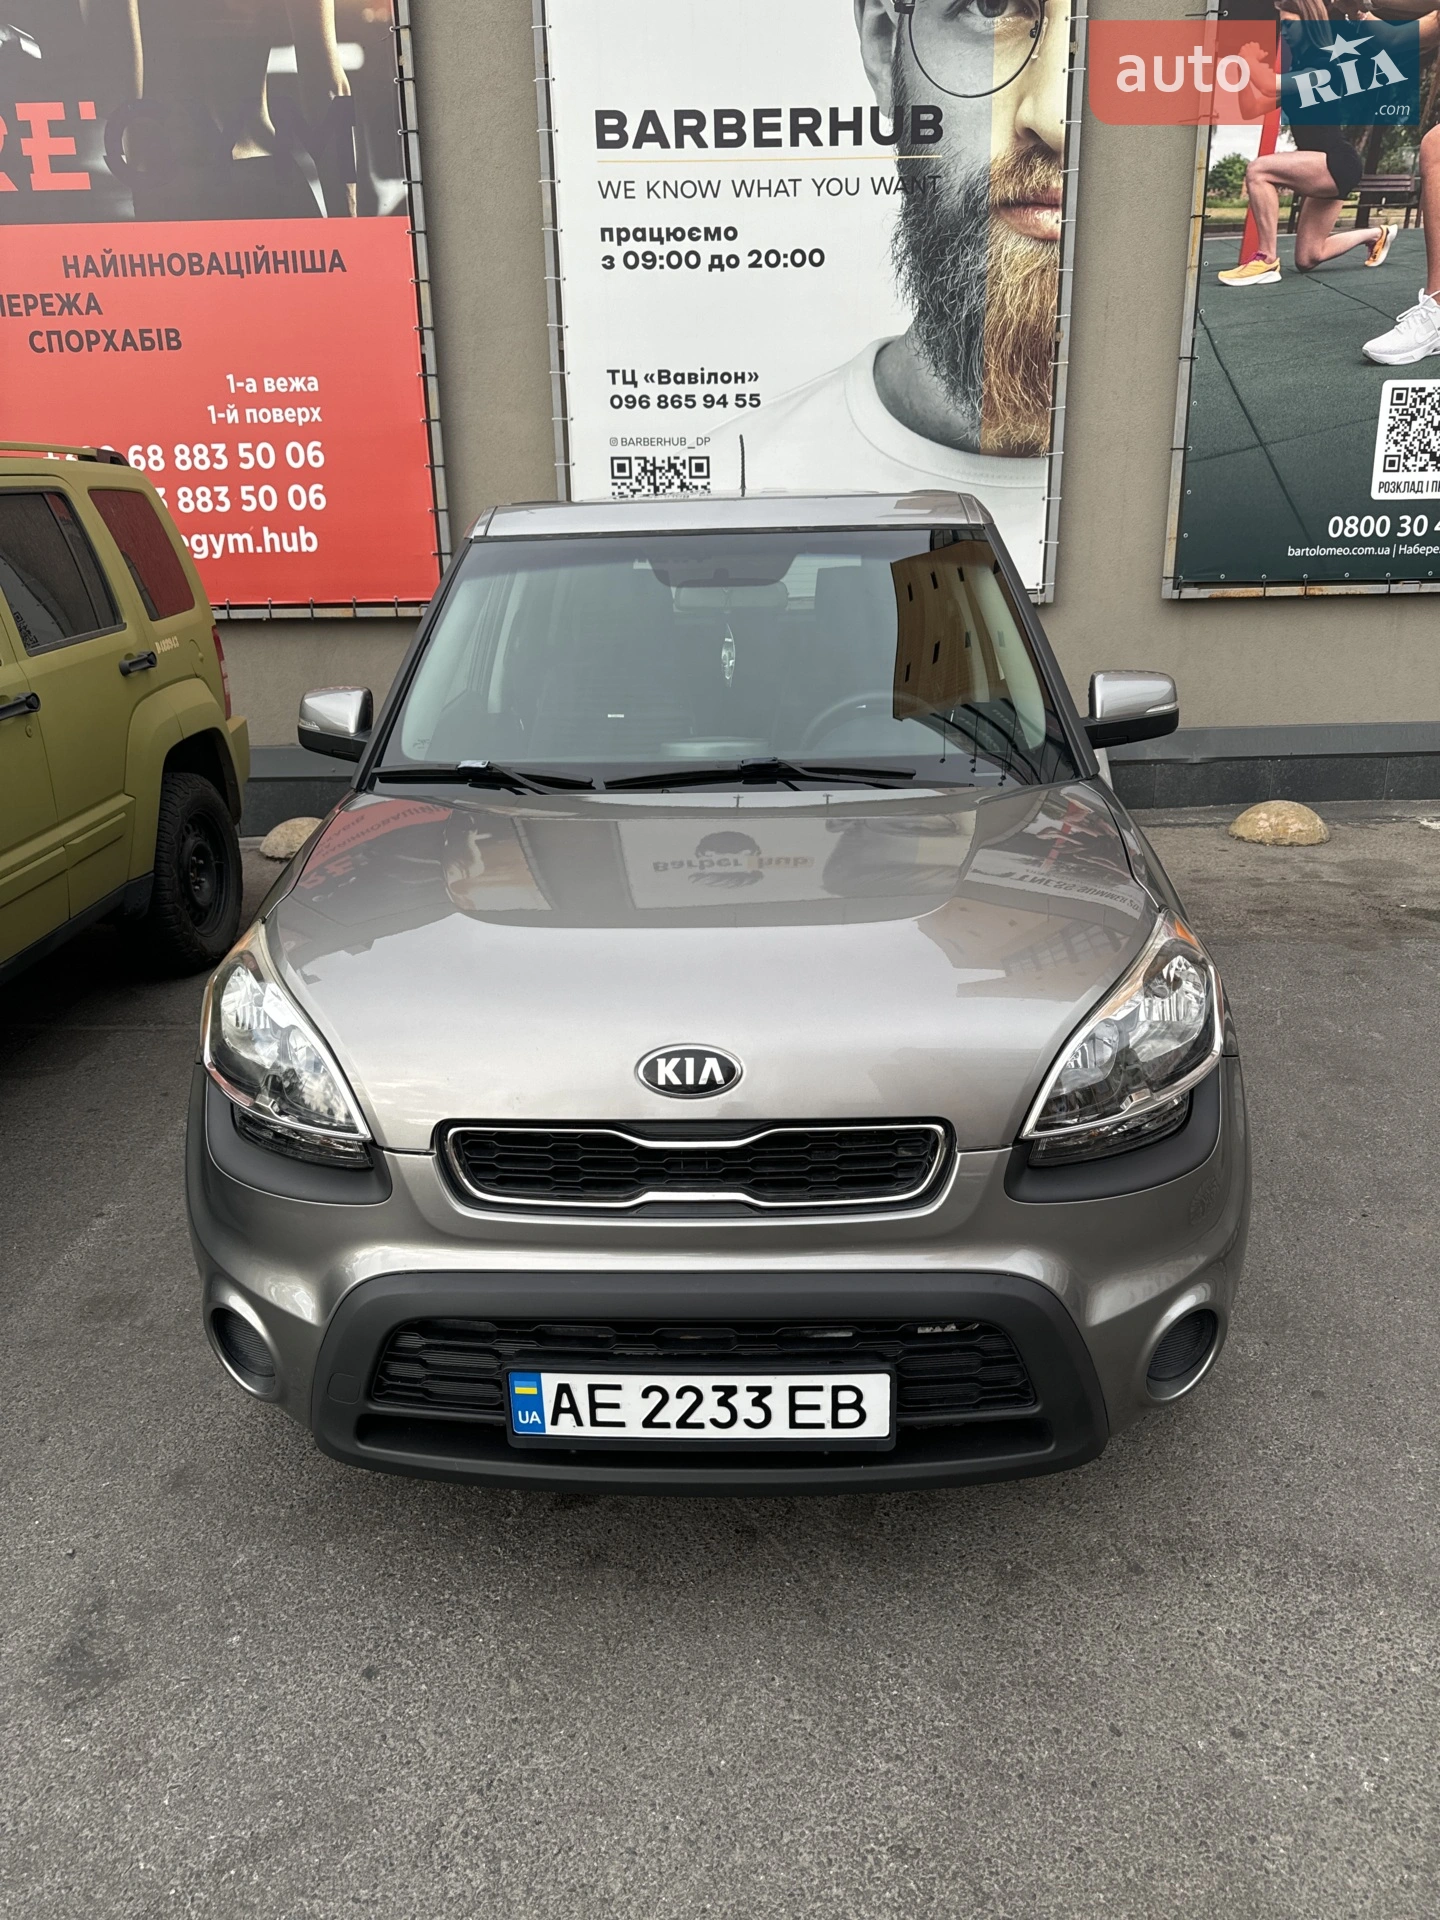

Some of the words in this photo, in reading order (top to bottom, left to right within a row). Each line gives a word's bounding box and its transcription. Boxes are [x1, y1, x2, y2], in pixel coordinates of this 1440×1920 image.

[595, 104, 944, 149] BARBERHUB
[597, 180, 636, 199] WE
[646, 180, 722, 199] KNOW
[731, 178, 803, 198] WHAT
[811, 177, 860, 197] YOU
[870, 175, 942, 196] WANT
[600, 226, 738, 246] працюємо
[62, 245, 347, 278] НАЙІННОВАЦІЙНІША
[601, 254, 615, 270] з
[622, 250, 701, 270] 09:00
[708, 253, 740, 272] до
[748, 248, 825, 269] 20:00
[28, 328, 183, 354] СПОРХАБІВ
[226, 373, 258, 394] 1-а
[263, 376, 319, 393] вежа
[606, 369, 638, 388] ТЦ
[643, 367, 760, 386] «Вавілон»
[609, 394, 651, 409] 096
[656, 394, 697, 409] 865
[702, 394, 729, 408] 94
[734, 393, 761, 408] 55
[207, 404, 240, 425] 1-й
[245, 406, 323, 427] поверх
[620, 437, 711, 449] BARBERHUB_DP
[127, 444, 166, 472] 68
[173, 443, 229, 471] 883
[237, 441, 277, 470] 50
[285, 440, 326, 469] 06
[176, 485, 232, 514] 883
[240, 484, 279, 512] 50
[287, 483, 328, 511] 06
[1378, 480, 1424, 494] РОЗКЛАД
[1328, 514, 1391, 538] 0800
[1396, 514, 1429, 538] 30
[1287, 545, 1391, 557] bartolomeo.com.ua
[1398, 543, 1440, 557] Набере
[656, 1057, 725, 1086] KIA
[518, 1410, 542, 1425] UA
[551, 1383, 626, 1428] AE
[641, 1385, 774, 1429] 2233
[788, 1384, 867, 1430] EB
